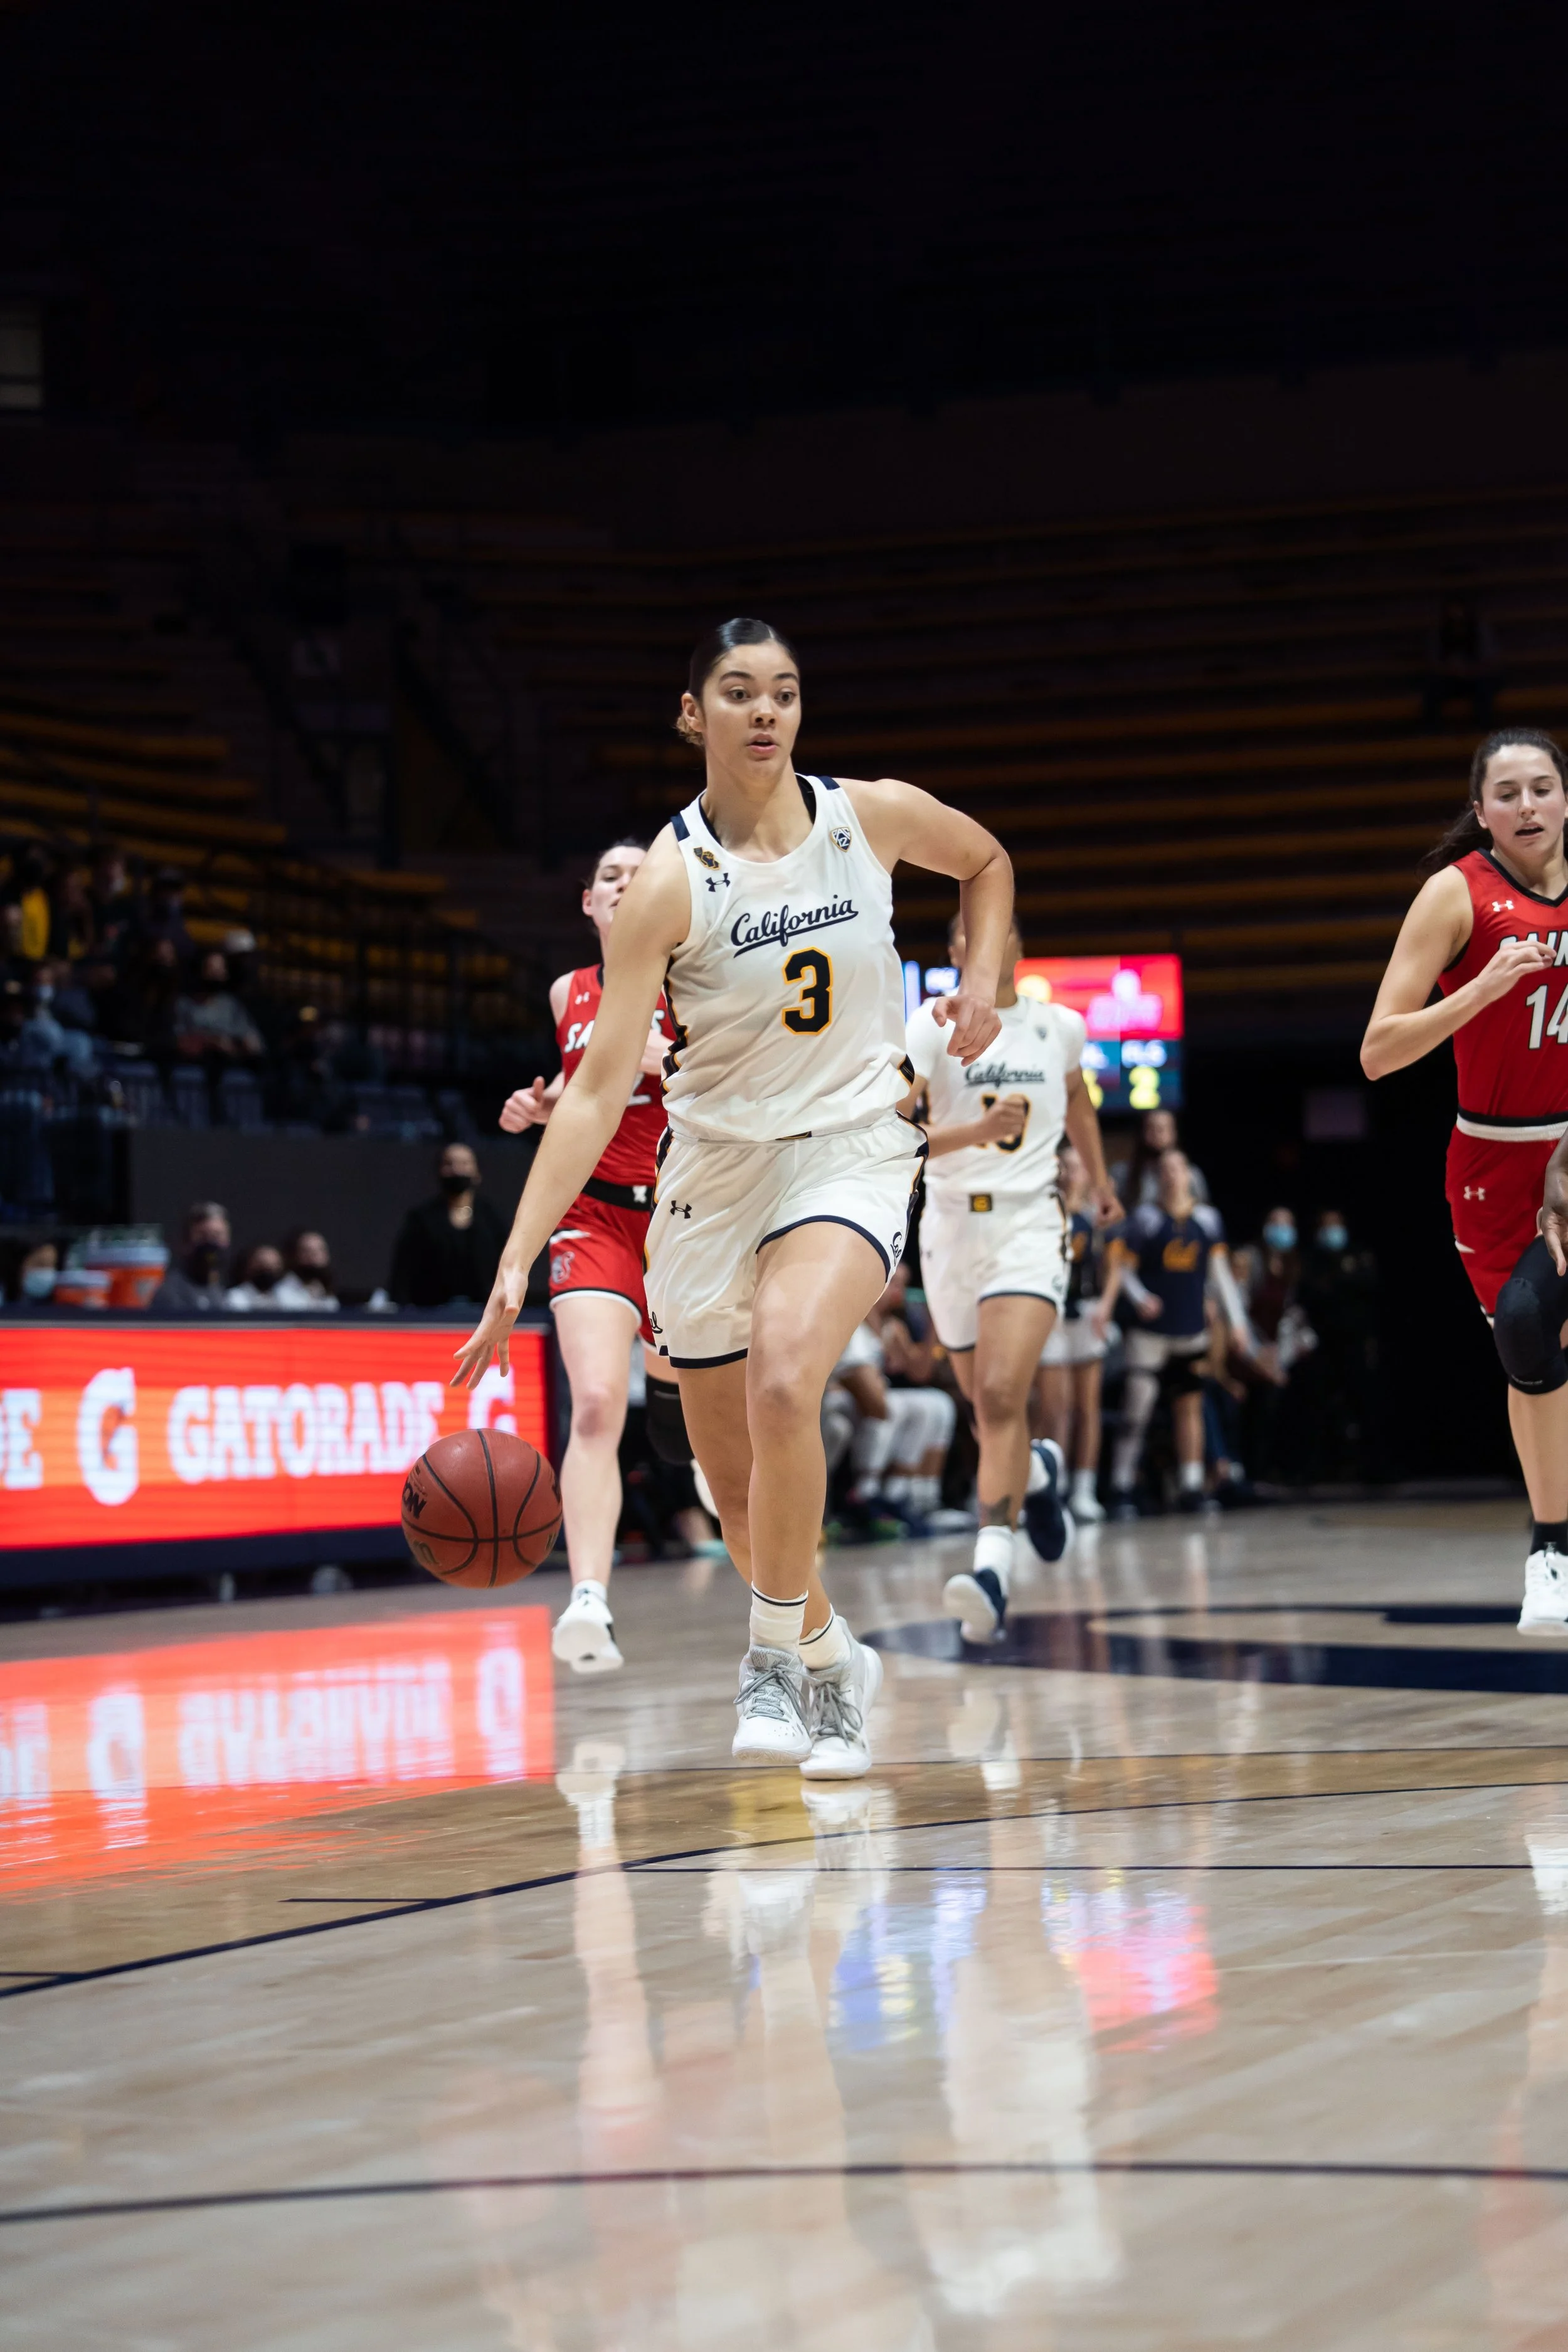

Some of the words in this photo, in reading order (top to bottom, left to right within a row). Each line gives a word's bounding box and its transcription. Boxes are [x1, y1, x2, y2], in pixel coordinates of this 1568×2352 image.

[731, 895, 859, 958] California
[781, 946, 834, 1036] 3
[965, 1061, 1046, 1088] California
[0, 1388, 43, 1490] E
[77, 1367, 139, 1506] G
[167, 1381, 444, 1485] GATORADE
